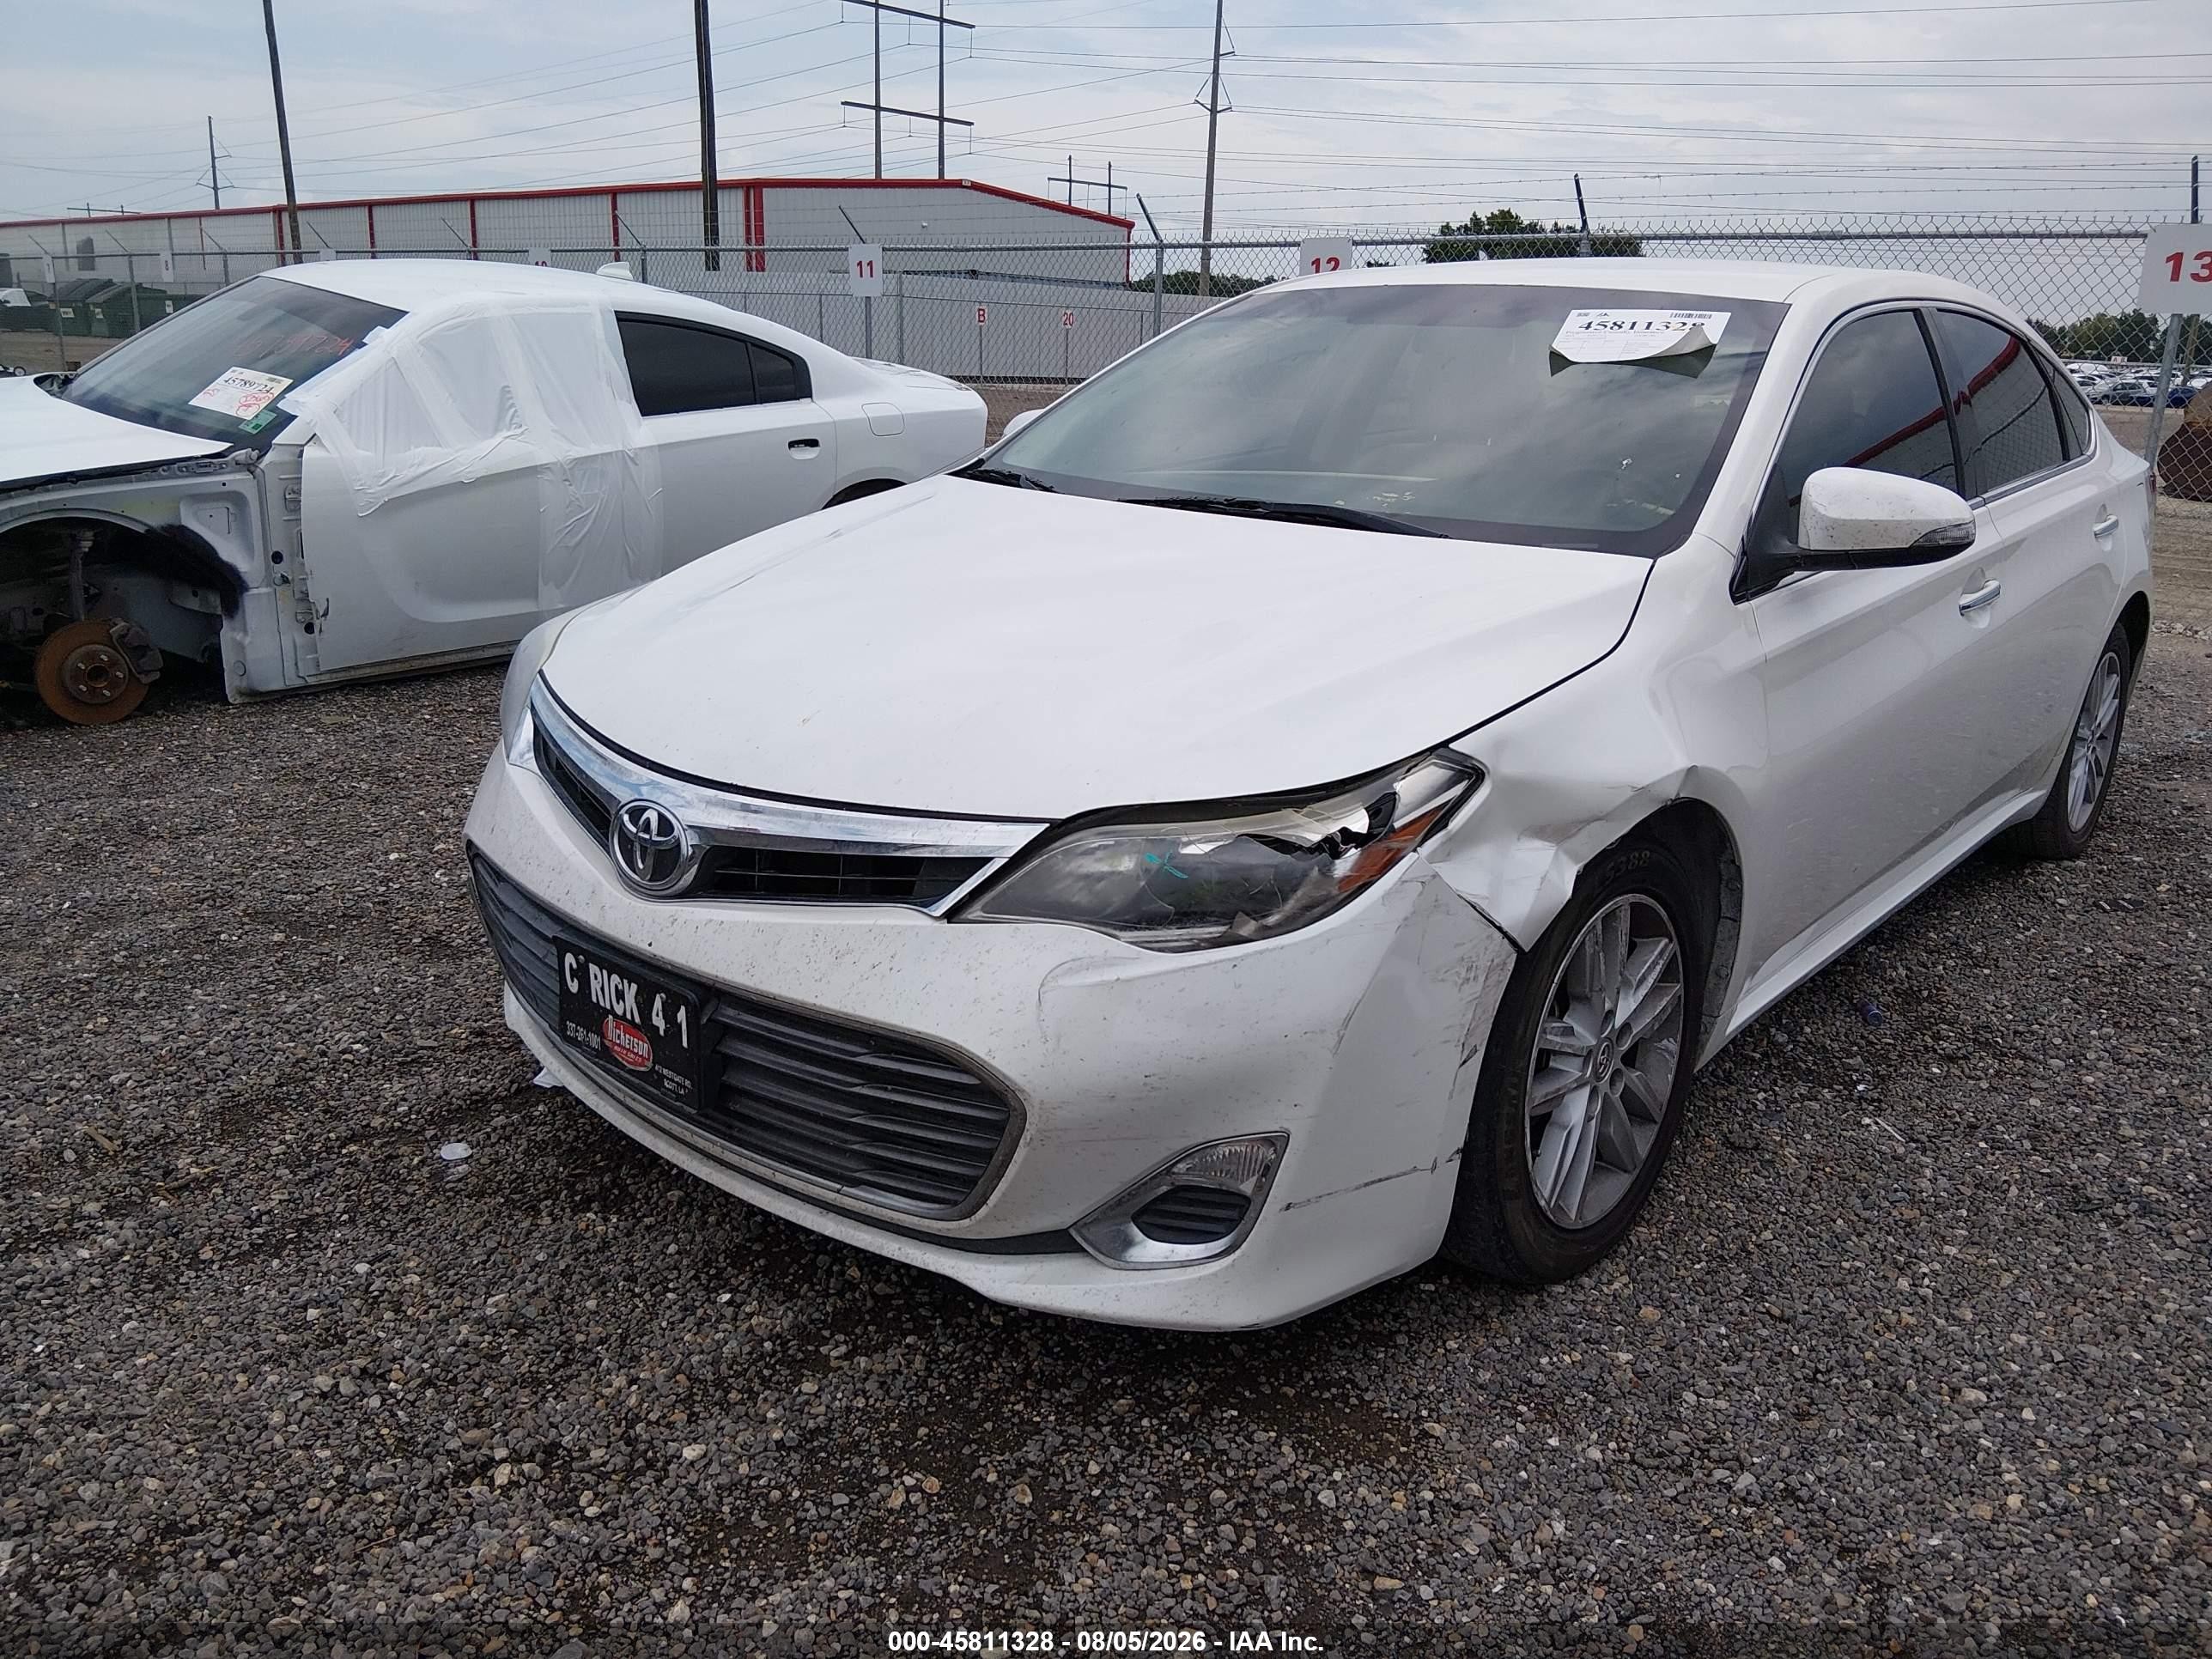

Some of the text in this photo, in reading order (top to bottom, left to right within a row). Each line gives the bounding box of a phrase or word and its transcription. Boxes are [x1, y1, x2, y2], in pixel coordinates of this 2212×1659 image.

[856, 260, 874, 278] 11
[1311, 257, 1340, 274] 12
[2165, 251, 2212, 283] 13
[977, 308, 986, 323] B
[1063, 312, 1074, 326] 20
[224, 376, 274, 393] 45789724
[564, 952, 579, 994] C
[589, 962, 641, 1025] RICK
